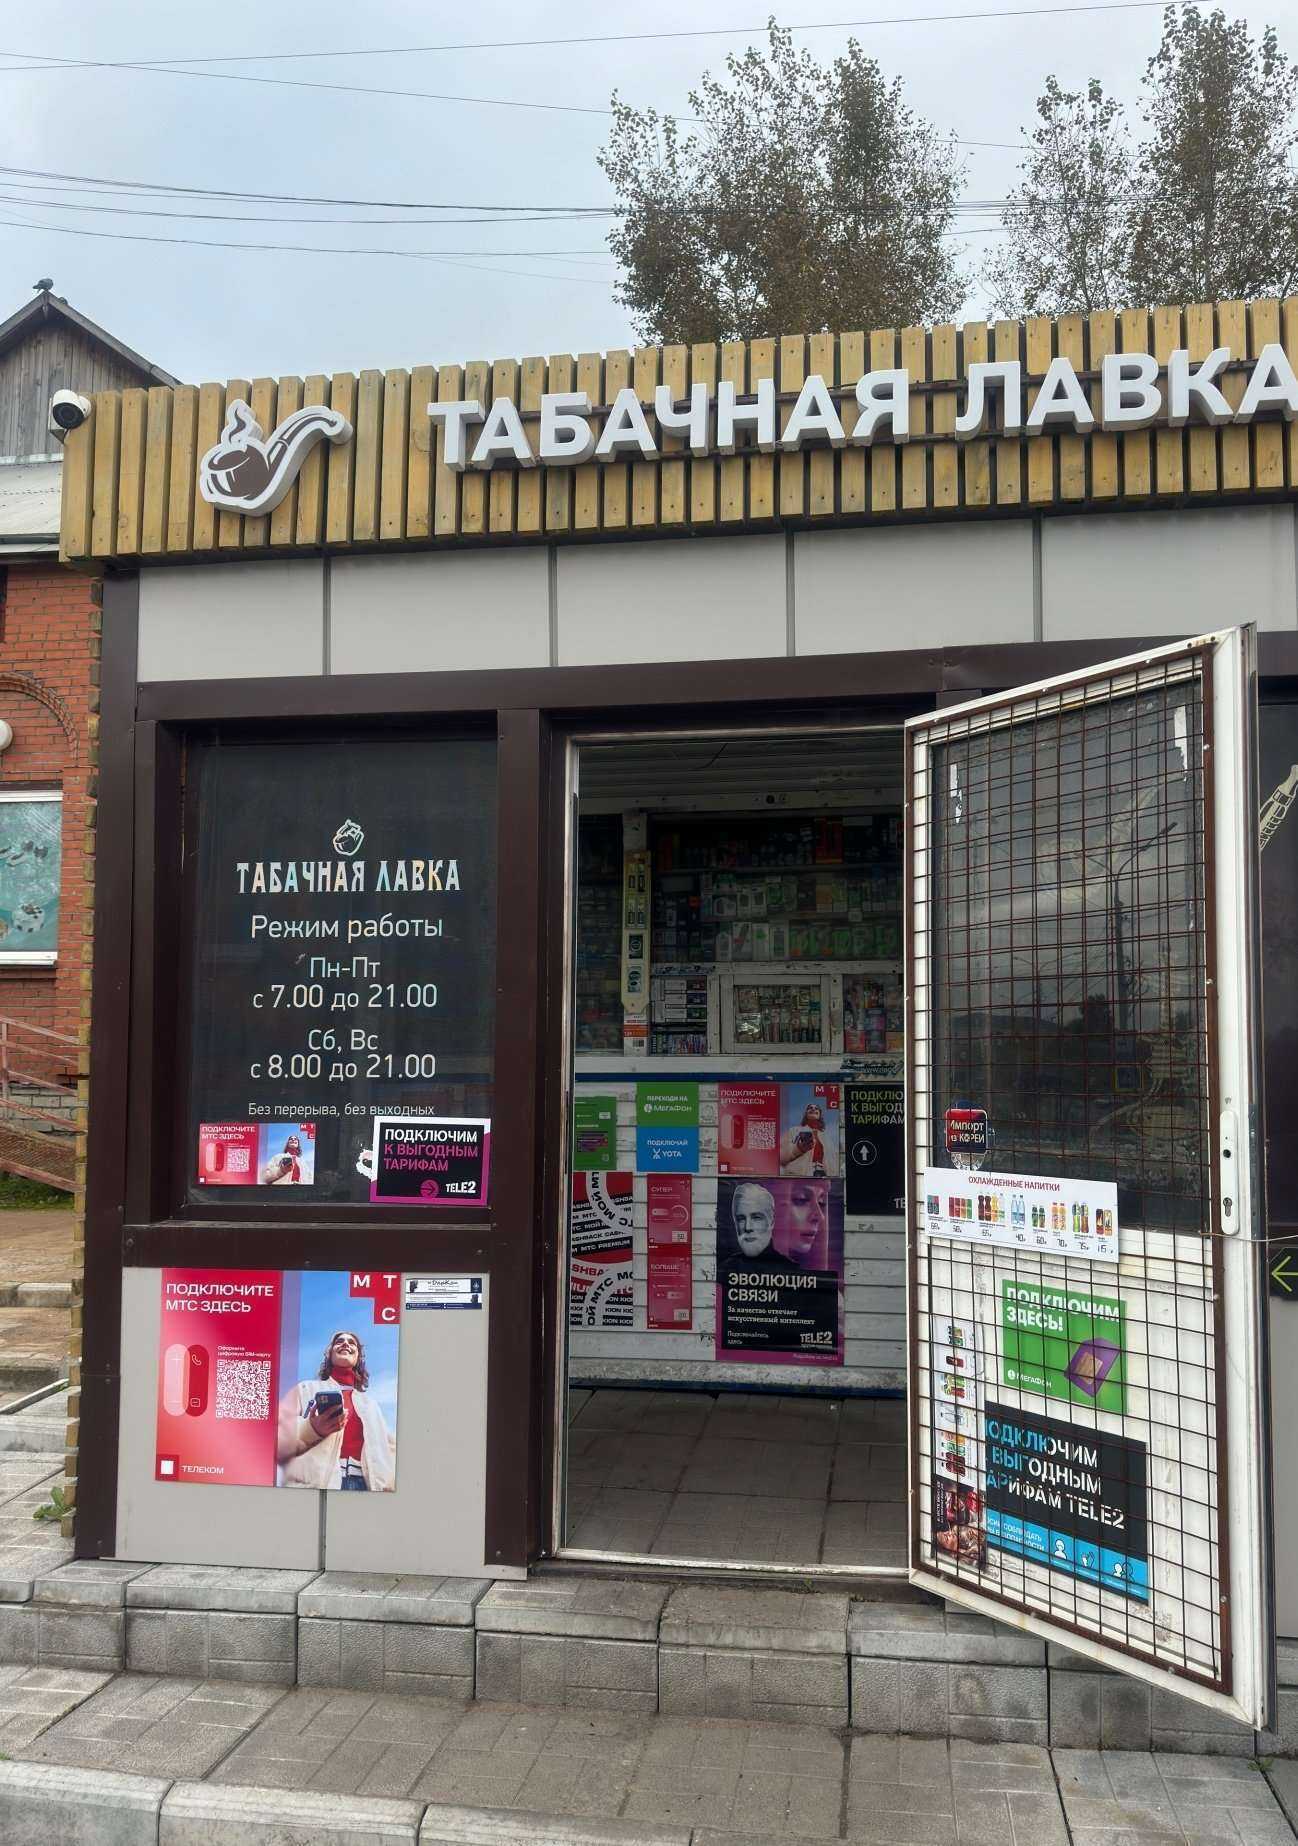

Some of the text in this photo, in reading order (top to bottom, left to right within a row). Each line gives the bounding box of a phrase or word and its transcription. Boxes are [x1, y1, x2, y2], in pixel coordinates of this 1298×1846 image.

[428, 343, 1298, 471] ТАБАЧНАЯ ЛАВКА
[236, 859, 462, 894] ТАБАЧНАЯ ЛАВКА
[250, 912, 444, 943] Режим работы
[309, 956, 381, 979] Пн-Пт
[252, 983, 438, 1012] с 7.00 до 21.00
[308, 1028, 379, 1055] Сб, Вс
[250, 1054, 437, 1083] с 8.00 до 21.00
[248, 1102, 435, 1118] Без перерыва, без выходных
[850, 1102, 905, 1114] К ВЫГОД
[384, 1128, 478, 1143] ПОДКЛЮЧИМ
[384, 1143, 479, 1158] К ВЫГОДНЫМ
[384, 1158, 449, 1171] ТАРИФАМ
[445, 1181, 477, 1194] TELE2
[968, 1175, 1061, 1192] ОХЛАЖДЕННЫЕ НАПИТКИ
[165, 1282, 274, 1297] ПОДКЛЮЧИТЕ
[728, 1272, 817, 1290] ЭВОЛЮЦИЯ
[728, 1288, 778, 1302] СВЯЗИ
[165, 1299, 252, 1314] МТС ЗДЕСЬ
[1006, 1287, 1120, 1322] ПОДКЛЮЧИМ
[1006, 1306, 1064, 1331] ЗДЕСЬ!
[800, 1331, 833, 1345] TELE2
[180, 1465, 225, 1475] ТЕЛЕКОМ
[992, 1445, 1101, 1495] ВЫГОДНЫМ
[986, 1470, 1062, 1509] АРИФАМ
